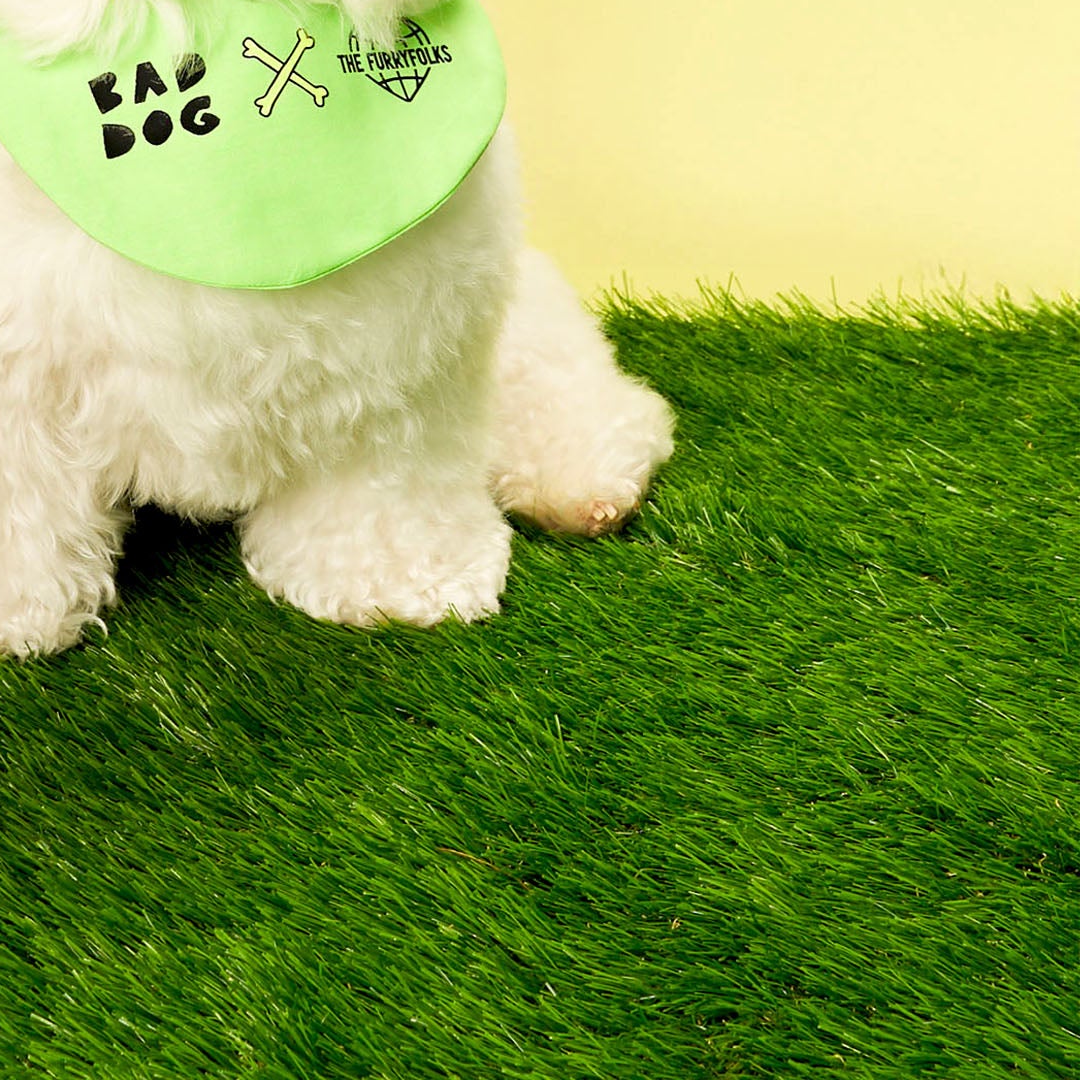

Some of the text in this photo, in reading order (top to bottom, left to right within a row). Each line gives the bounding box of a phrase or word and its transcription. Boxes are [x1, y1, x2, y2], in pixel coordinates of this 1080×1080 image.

[87, 52, 207, 115] BAD
[336, 44, 453, 74] THE FURRYFOLKS
[102, 95, 221, 160] DOG
